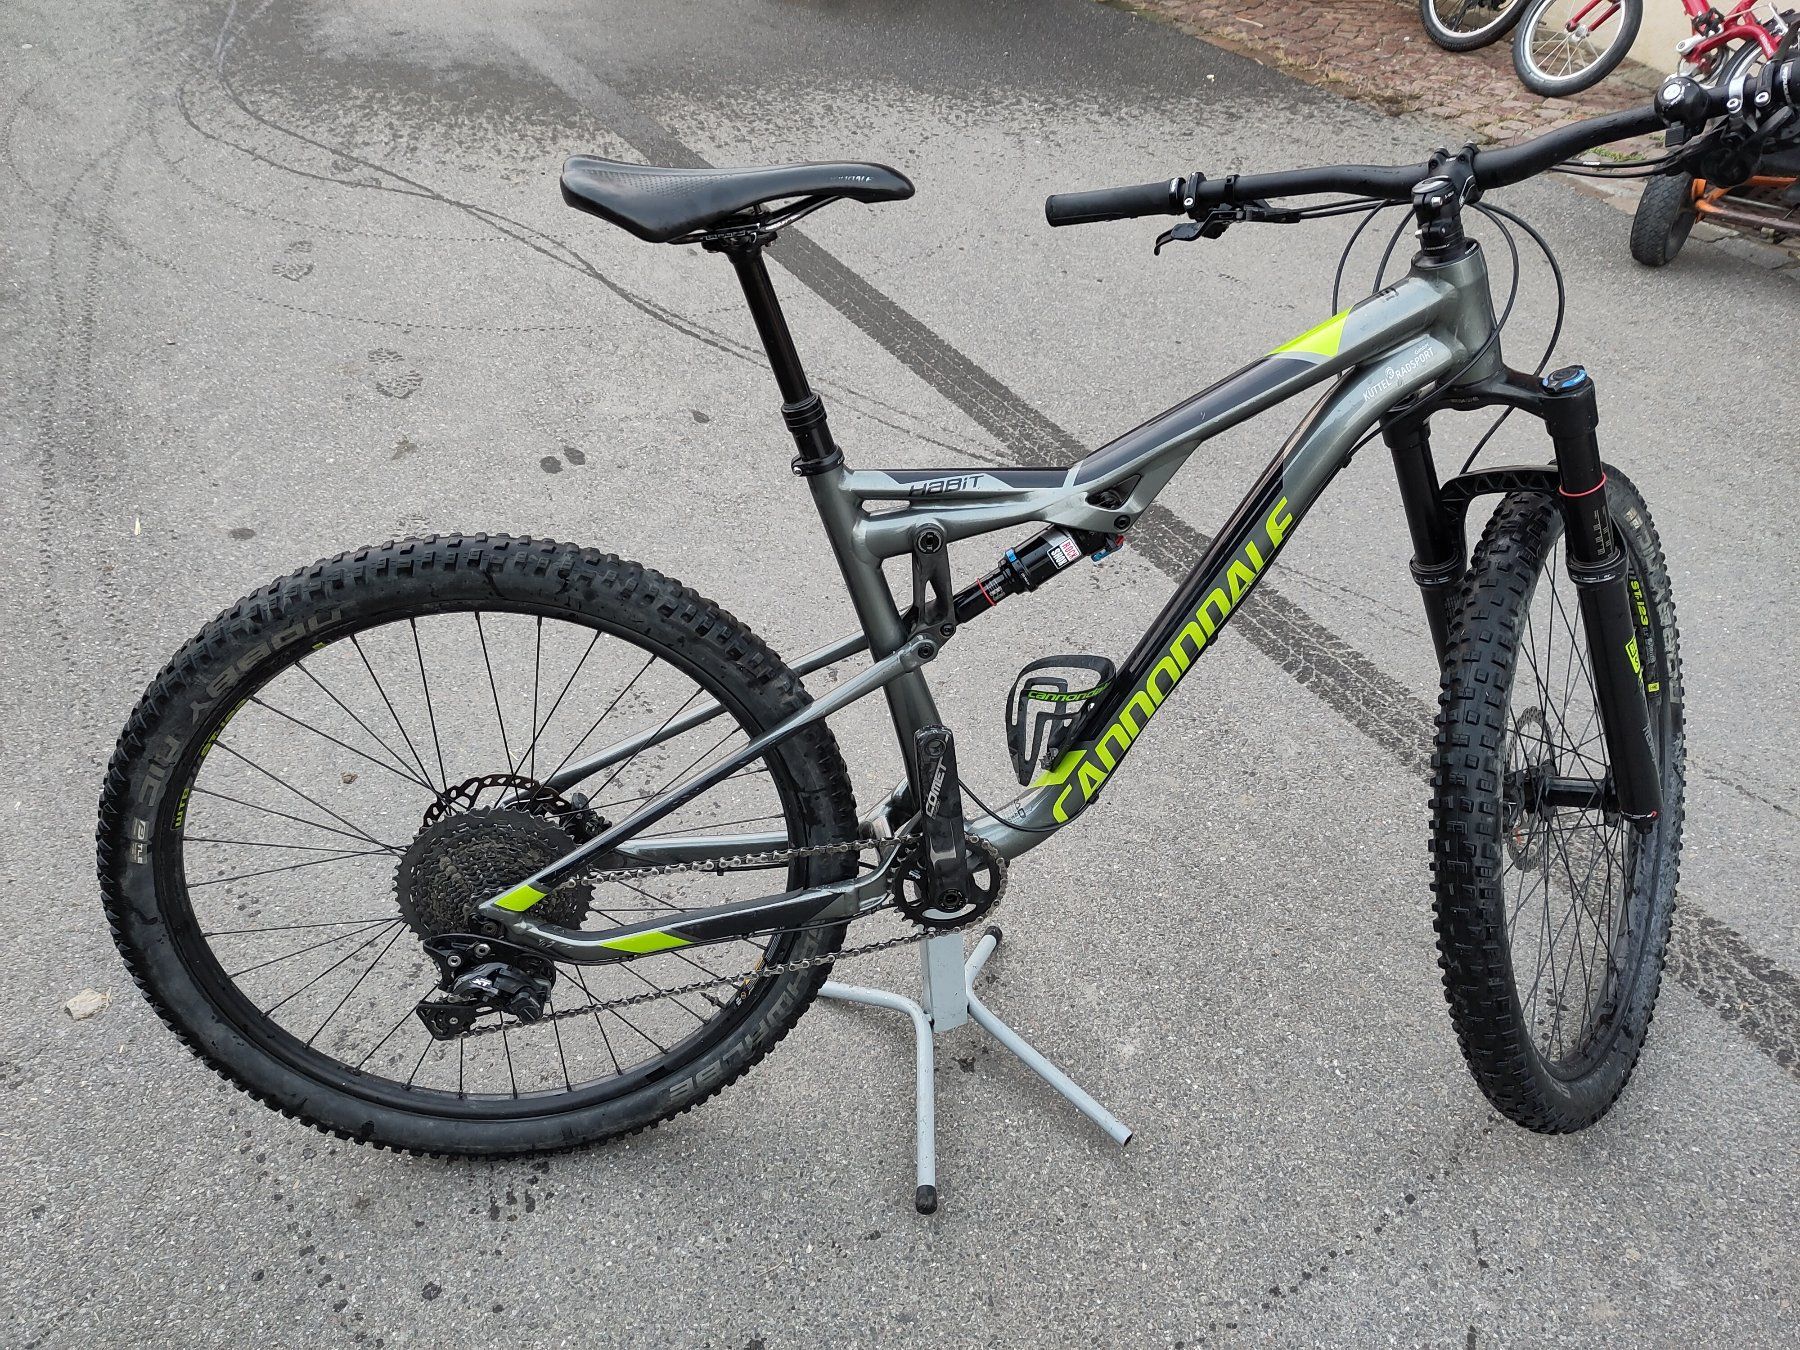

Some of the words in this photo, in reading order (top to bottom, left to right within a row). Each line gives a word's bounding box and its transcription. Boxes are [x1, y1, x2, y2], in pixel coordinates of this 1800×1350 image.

[1363, 376, 1394, 401] KÜTTEL
[1395, 347, 1435, 380] RADSPORT
[1051, 548, 1067, 566] SHOX
[1062, 541, 1078, 559] ROCK
[925, 757, 948, 818] COMET
